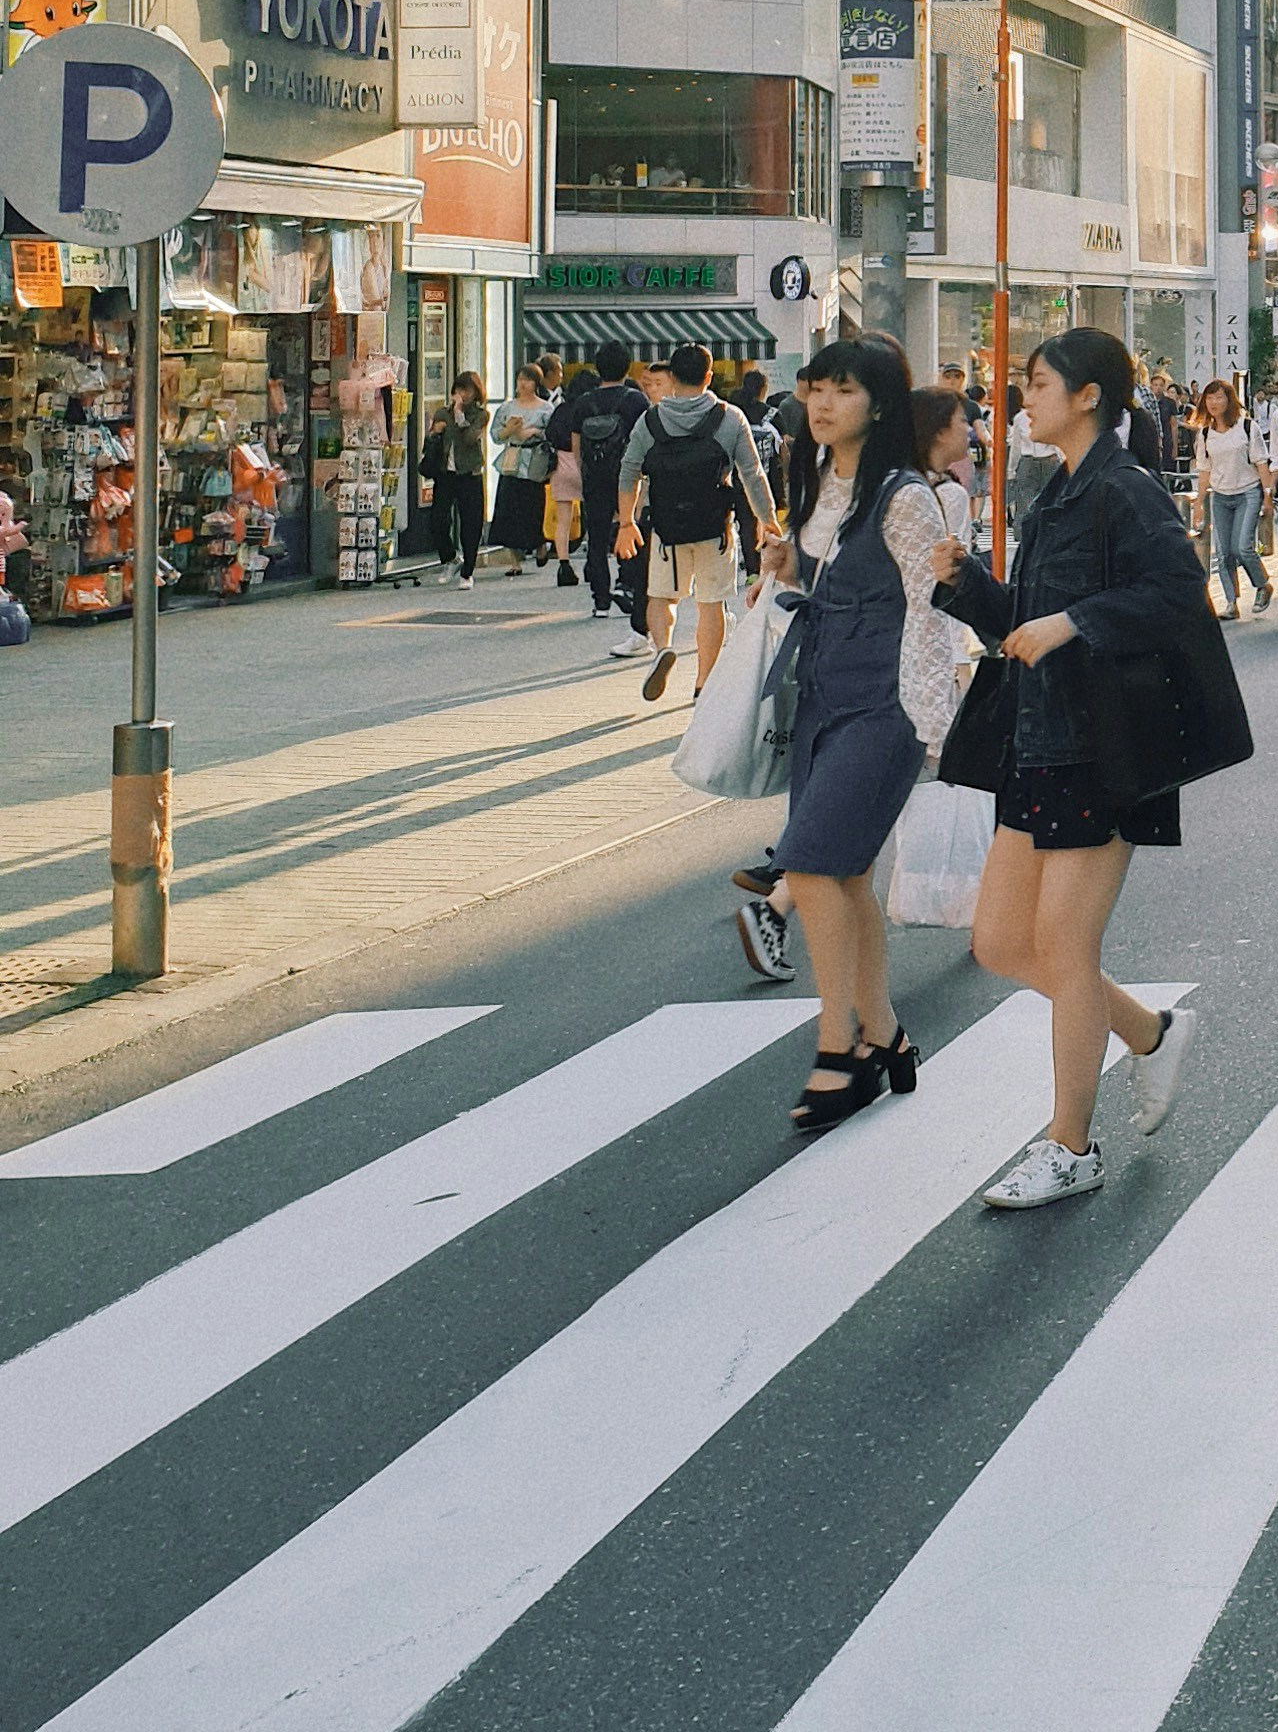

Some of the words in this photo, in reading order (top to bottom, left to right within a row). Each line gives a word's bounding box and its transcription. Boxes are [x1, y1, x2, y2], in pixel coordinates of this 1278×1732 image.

[410, 44, 462, 60] Prédia
[244, 59, 384, 115] PHARMACY
[407, 92, 465, 107] ALBION
[59, 61, 173, 213] P
[464, 116, 524, 168] ECHO
[1083, 222, 1124, 253] ZARA
[524, 263, 619, 289] SIOR
[1226, 314, 1239, 370] ZARA
